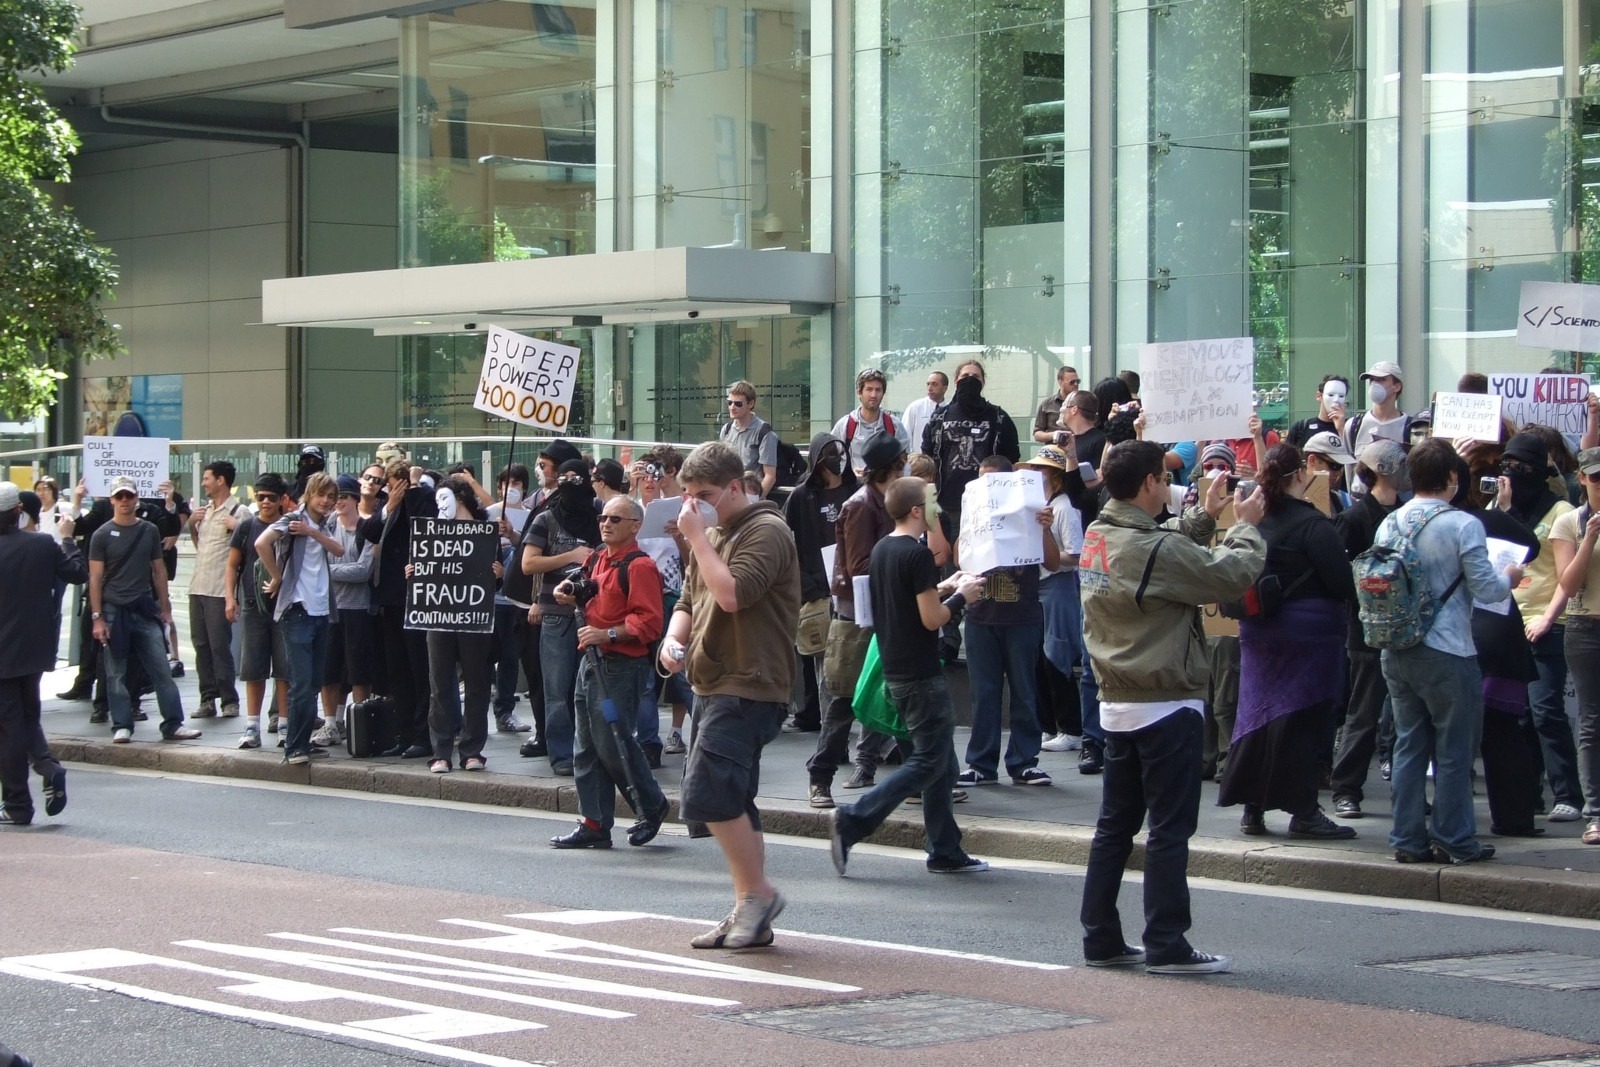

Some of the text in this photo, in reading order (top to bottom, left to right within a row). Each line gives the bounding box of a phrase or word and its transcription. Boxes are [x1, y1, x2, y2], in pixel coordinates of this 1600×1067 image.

[491, 333, 575, 378] SUPER
[1157, 339, 1244, 368] REMOVE
[488, 356, 564, 398] POWERS
[1165, 385, 1225, 407] TAX
[1492, 376, 1590, 405] YOU KILLED
[1441, 396, 1493, 410] CAN I HAS
[1145, 402, 1239, 429] EXEMPTION
[1441, 408, 1496, 422] TAX EXEMPT
[1441, 420, 1461, 431] NOW
[87, 442, 113, 450] CULT
[101, 451, 115, 459] OF
[94, 459, 160, 469] SCIENTOLOGY
[103, 468, 155, 478] DESTROYS
[103, 479, 153, 488] FIES
[412, 539, 474, 558] IS DEAD
[414, 561, 463, 577] BUT HIS
[412, 582, 486, 606] FRAUD
